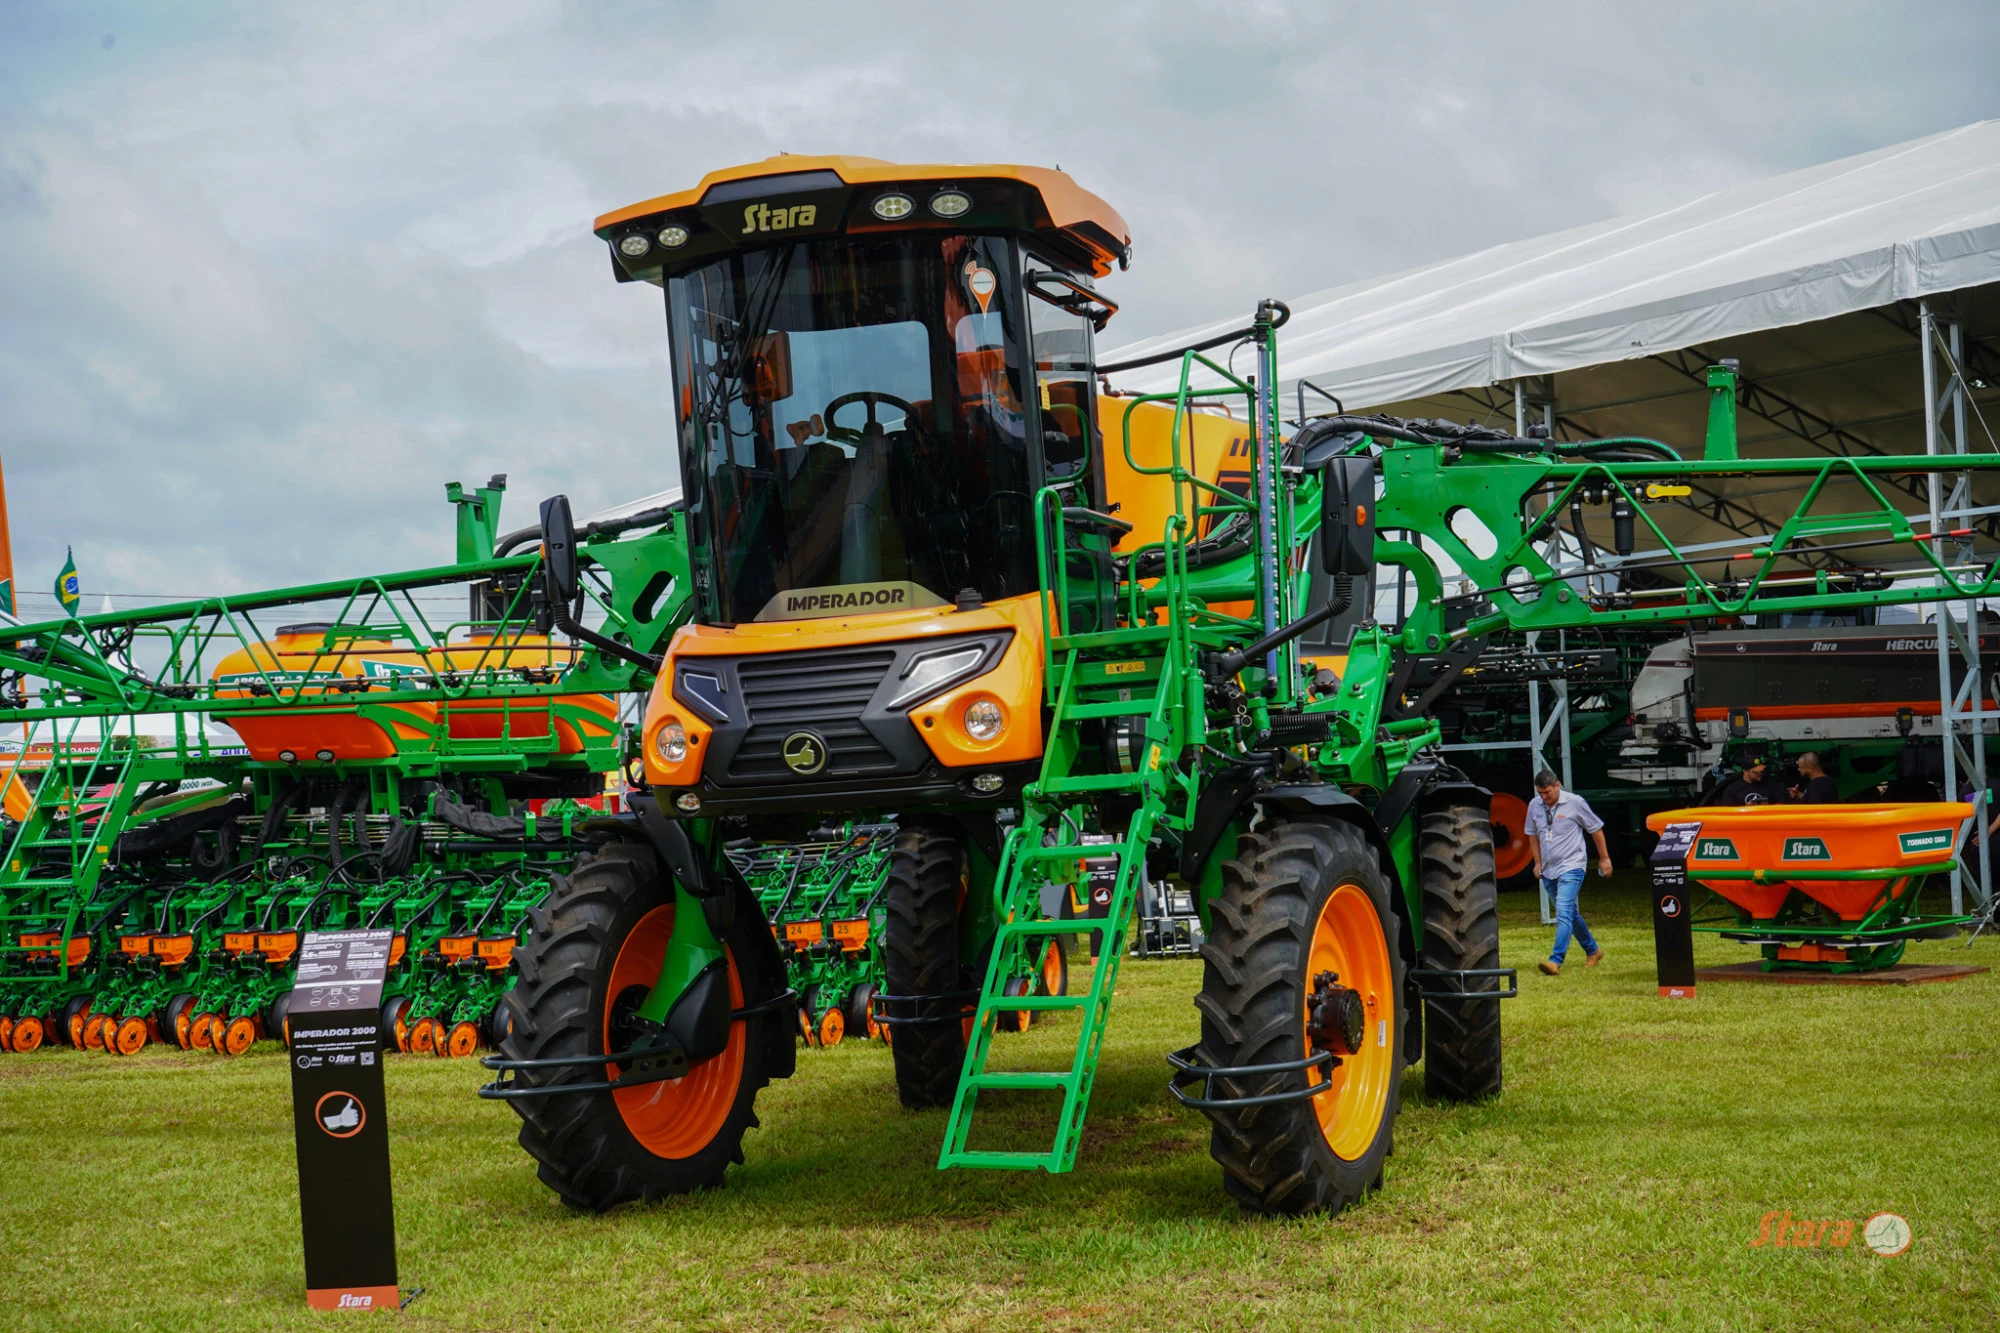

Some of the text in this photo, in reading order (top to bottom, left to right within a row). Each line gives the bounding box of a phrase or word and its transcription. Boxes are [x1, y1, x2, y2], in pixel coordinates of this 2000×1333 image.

[742, 203, 817, 234] Stara
[787, 588, 905, 612] IMPERADOR
[1811, 641, 1838, 652] Stara
[1906, 837, 1934, 847] TORNADO
[1702, 842, 1730, 856] Stara
[1791, 841, 1821, 856] Stara
[791, 926, 803, 935] 24
[837, 925, 849, 935] 25
[230, 937, 239, 946] 14
[317, 932, 369, 941] IMPERADOR
[25, 938, 33, 947] 10
[126, 939, 135, 948] 12
[158, 940, 167, 950] 13
[263, 938, 273, 947] 15
[446, 941, 455, 950] 18
[483, 945, 493, 954] 19
[293, 1026, 377, 1039] IMPERADOR 2000
[338, 1294, 373, 1307] Stara
